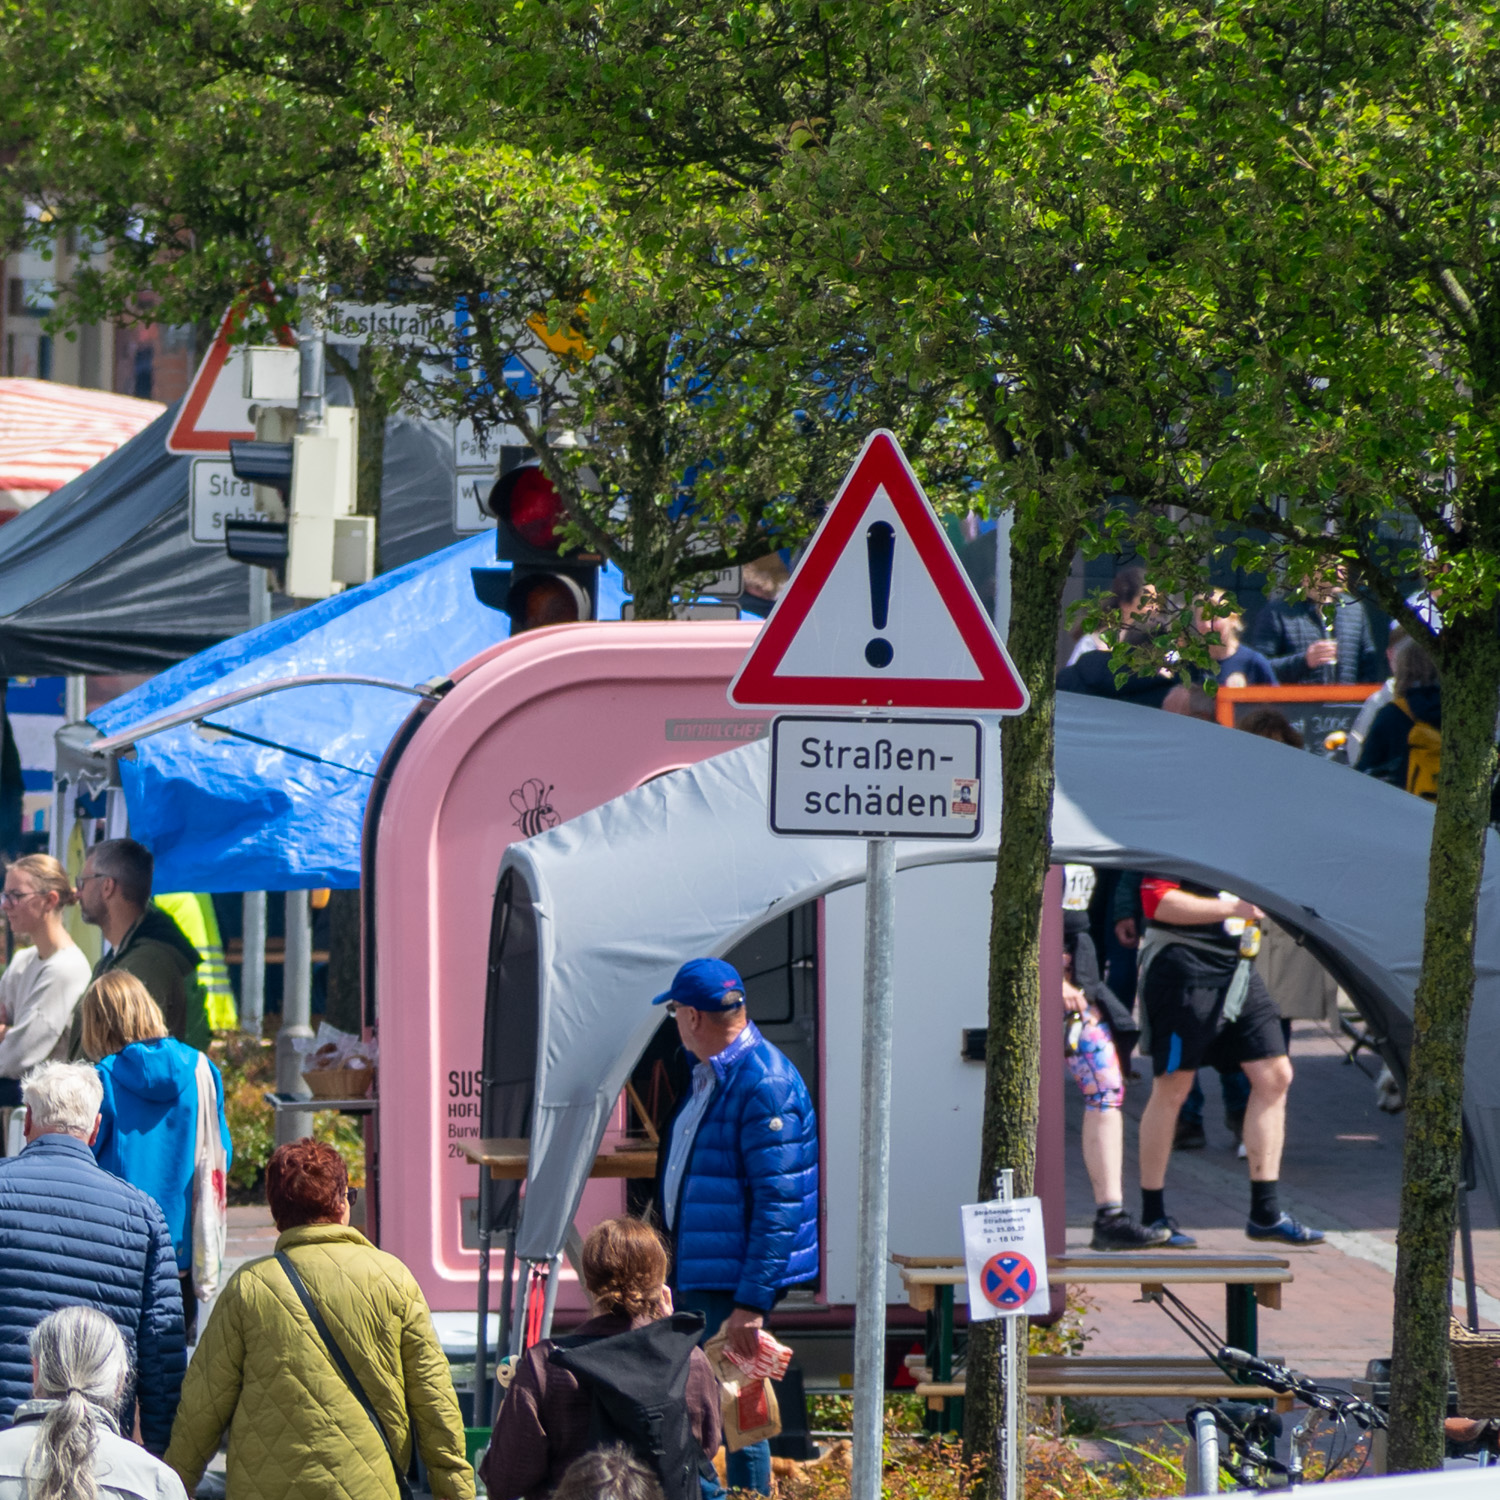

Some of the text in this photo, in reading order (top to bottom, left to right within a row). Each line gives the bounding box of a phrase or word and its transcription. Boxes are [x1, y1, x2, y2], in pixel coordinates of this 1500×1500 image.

[209, 473, 251, 497] Stra
[673, 721, 765, 739] MOBILCHEF
[800, 737, 955, 772] Straßen-
[804, 784, 949, 818] schäden
[974, 1207, 1031, 1217] Straßensperrung
